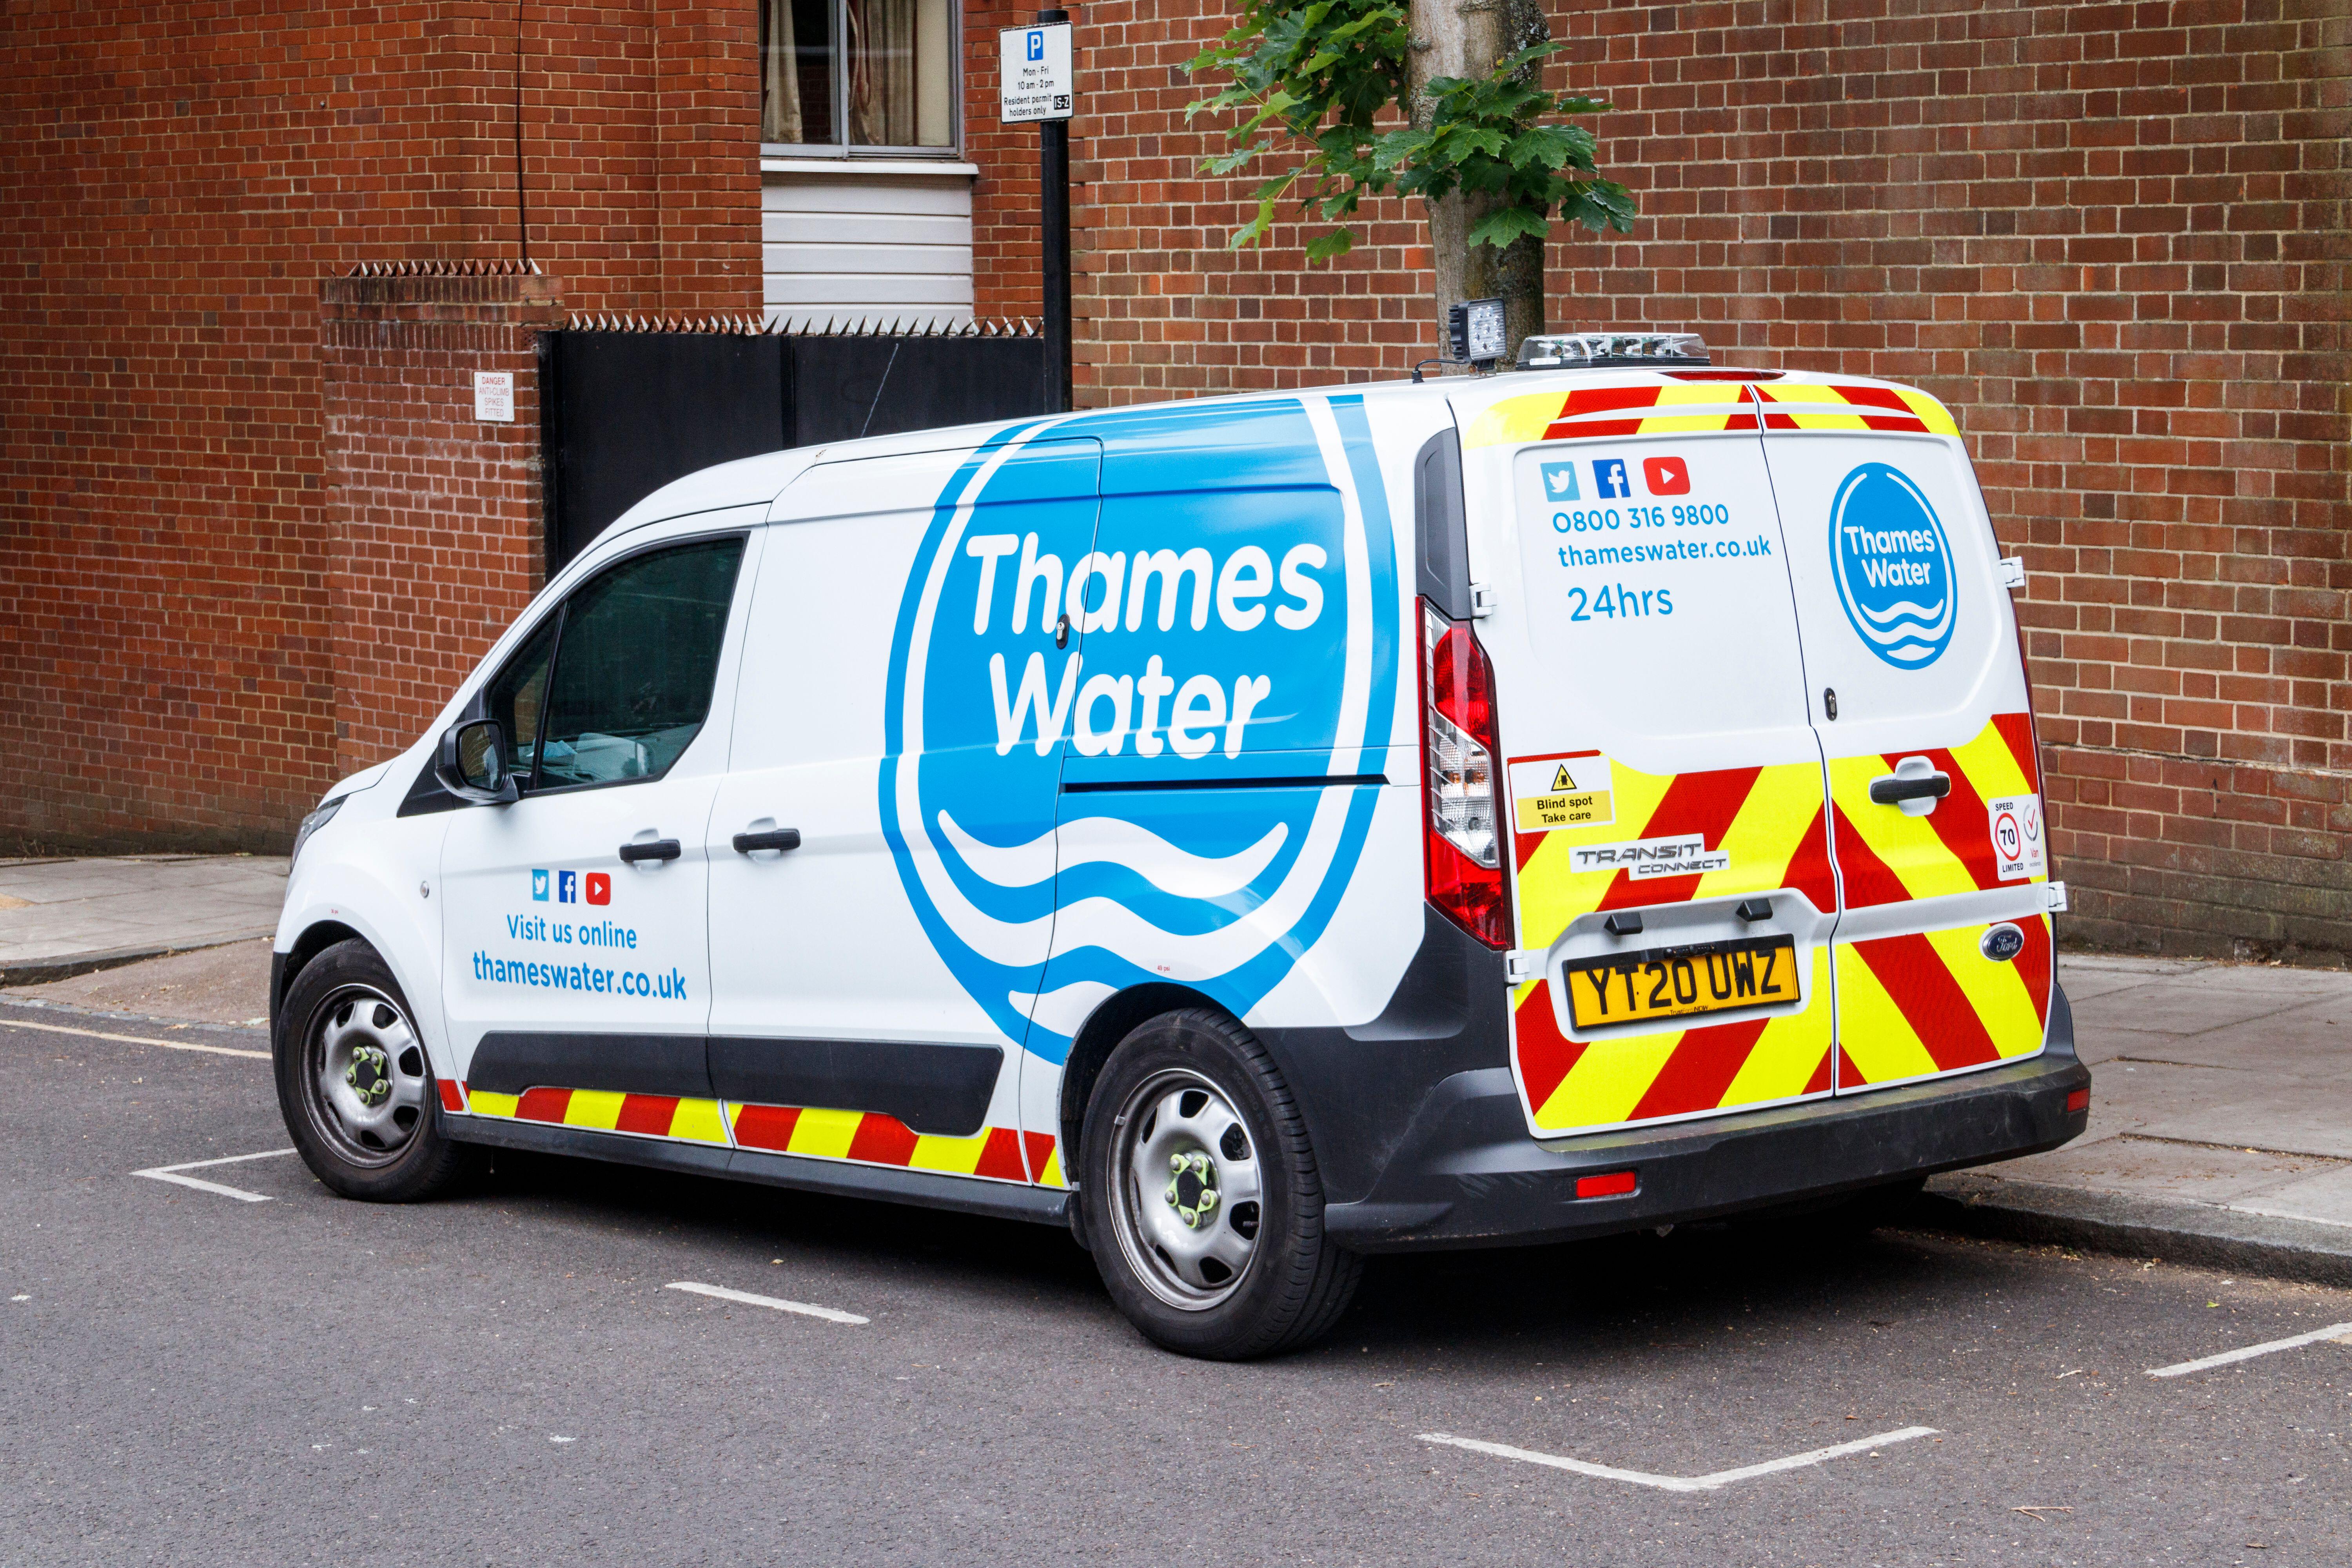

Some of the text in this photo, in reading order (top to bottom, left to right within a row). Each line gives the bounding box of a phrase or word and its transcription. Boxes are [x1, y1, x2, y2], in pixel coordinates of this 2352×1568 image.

[1031, 34, 1041, 58] P
[1023, 68, 1036, 76] Mon
[1018, 81, 1025, 90] 10
[1040, 80, 1044, 88] 2
[1045, 80, 1054, 90] pm
[1004, 93, 1052, 105] Resident permit
[1054, 96, 1069, 108] IS-Z
[1033, 106, 1046, 115] only
[482, 376, 505, 385] DANGER
[479, 387, 509, 396] ANTI-CLIMB
[485, 397, 504, 406] SPIKES
[485, 408, 504, 417] FITTED
[1553, 504, 1729, 533] 0800 316 9800
[1843, 525, 1935, 555] Thames
[1558, 535, 1771, 567] thameswater.co.uk
[1861, 558, 1931, 588] Water
[966, 532, 1327, 635] Thames
[1568, 583, 1673, 622] 24hrs
[989, 651, 1271, 760] Water
[1537, 795, 1593, 810] Blind spot
[1995, 802, 2013, 811] SPEED
[1541, 811, 1592, 824] Take care
[2000, 828, 2015, 846] 70
[1576, 843, 1701, 865] TRANSIT
[2030, 847, 2039, 858] Van
[1637, 858, 1727, 875] CONNECT
[2002, 863, 2024, 873] LIMITED
[507, 914, 637, 949] Visit us online
[1996, 935, 2018, 953] Ford
[473, 950, 686, 1000] thameswater.co.uk
[1586, 949, 1781, 1015] YT20 UWZ
